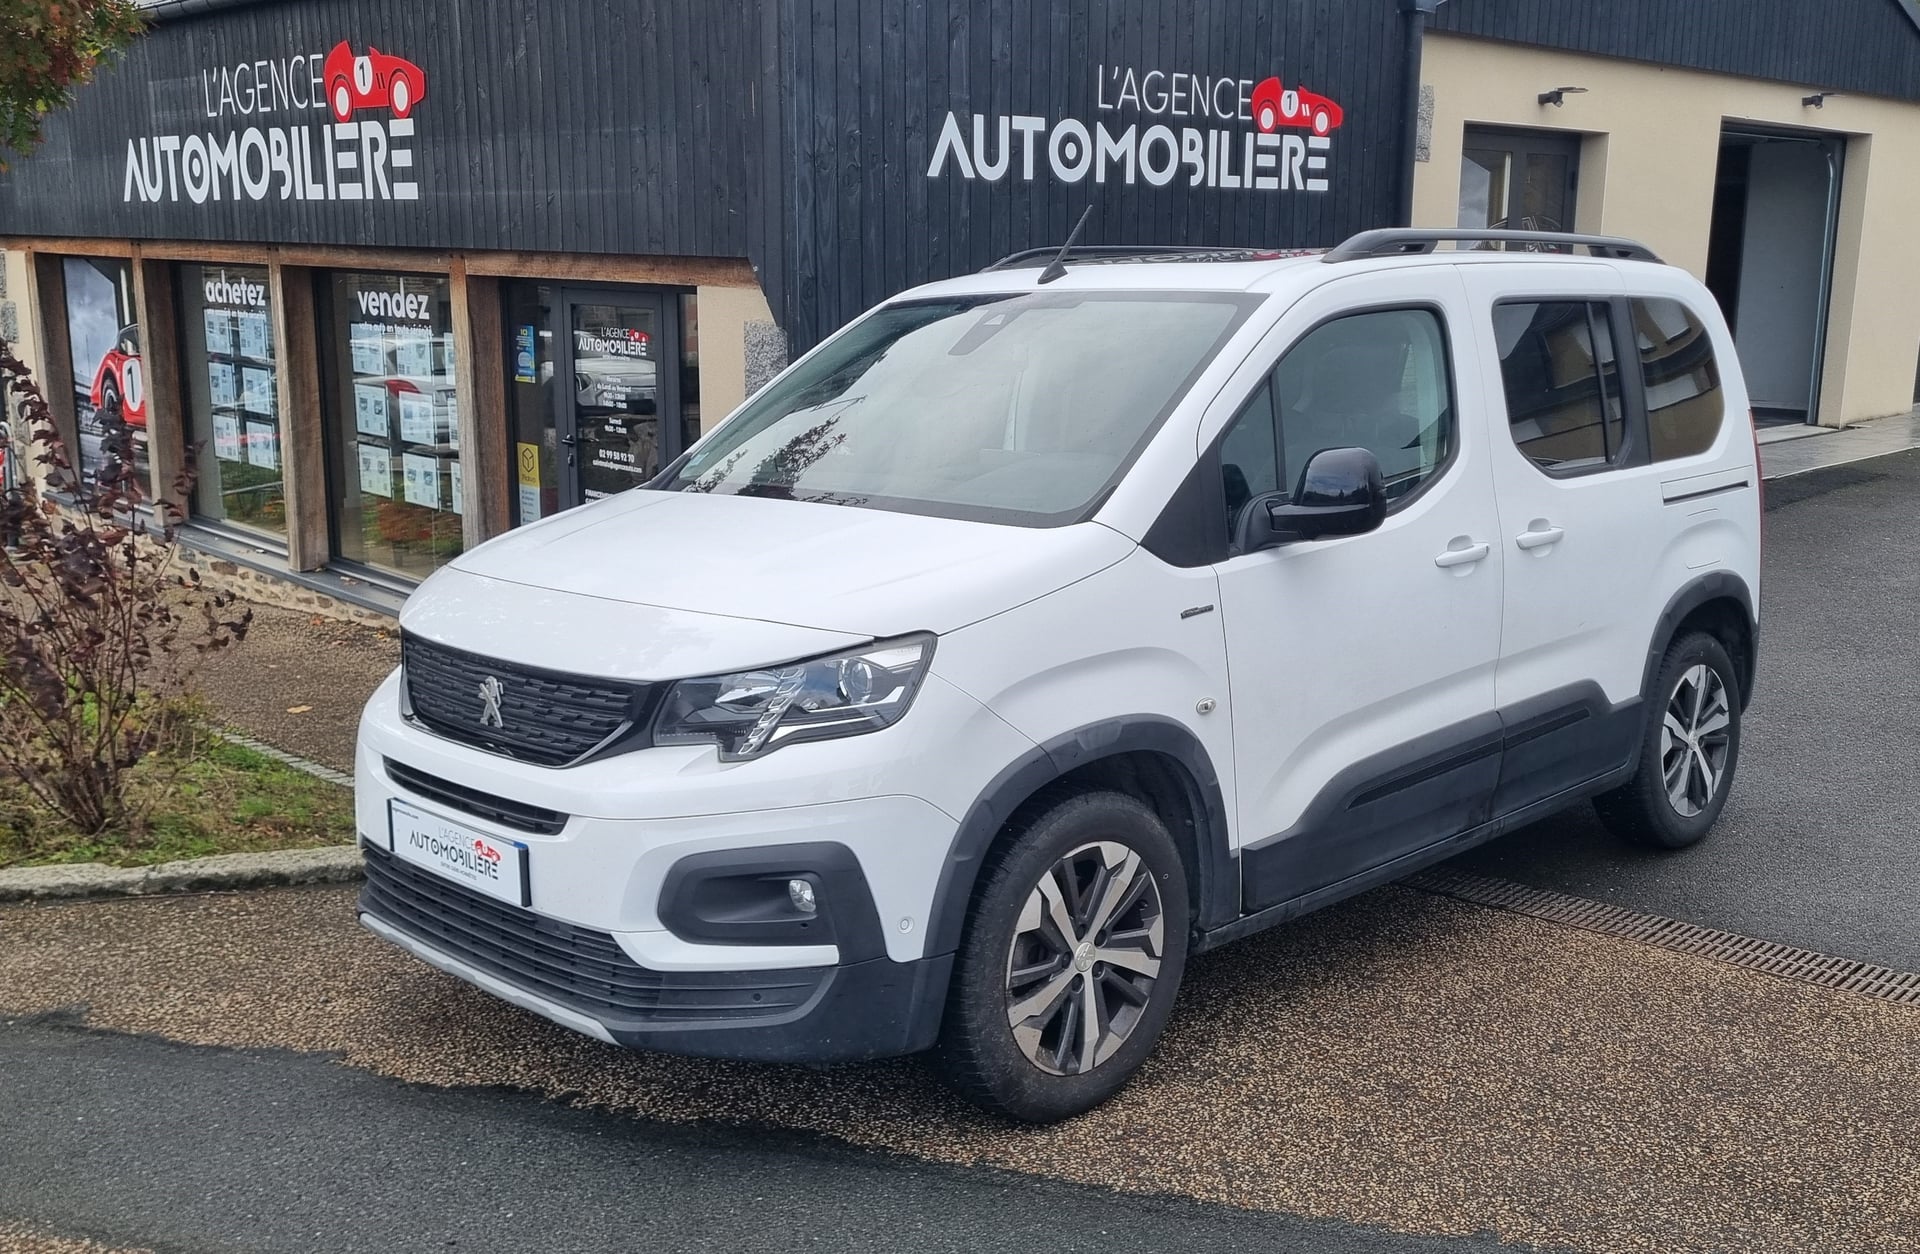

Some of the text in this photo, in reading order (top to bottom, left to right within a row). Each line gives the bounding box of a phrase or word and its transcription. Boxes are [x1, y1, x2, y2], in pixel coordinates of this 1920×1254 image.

[203, 54, 327, 117] L'AGENCE
[1098, 64, 1254, 121] L'AGENCE
[205, 269, 266, 306] achetez
[357, 277, 430, 320] vendez
[601, 327, 630, 339] L'AGENCE
[126, 365, 136, 404] 1
[438, 826, 476, 851] L'AGENCE
